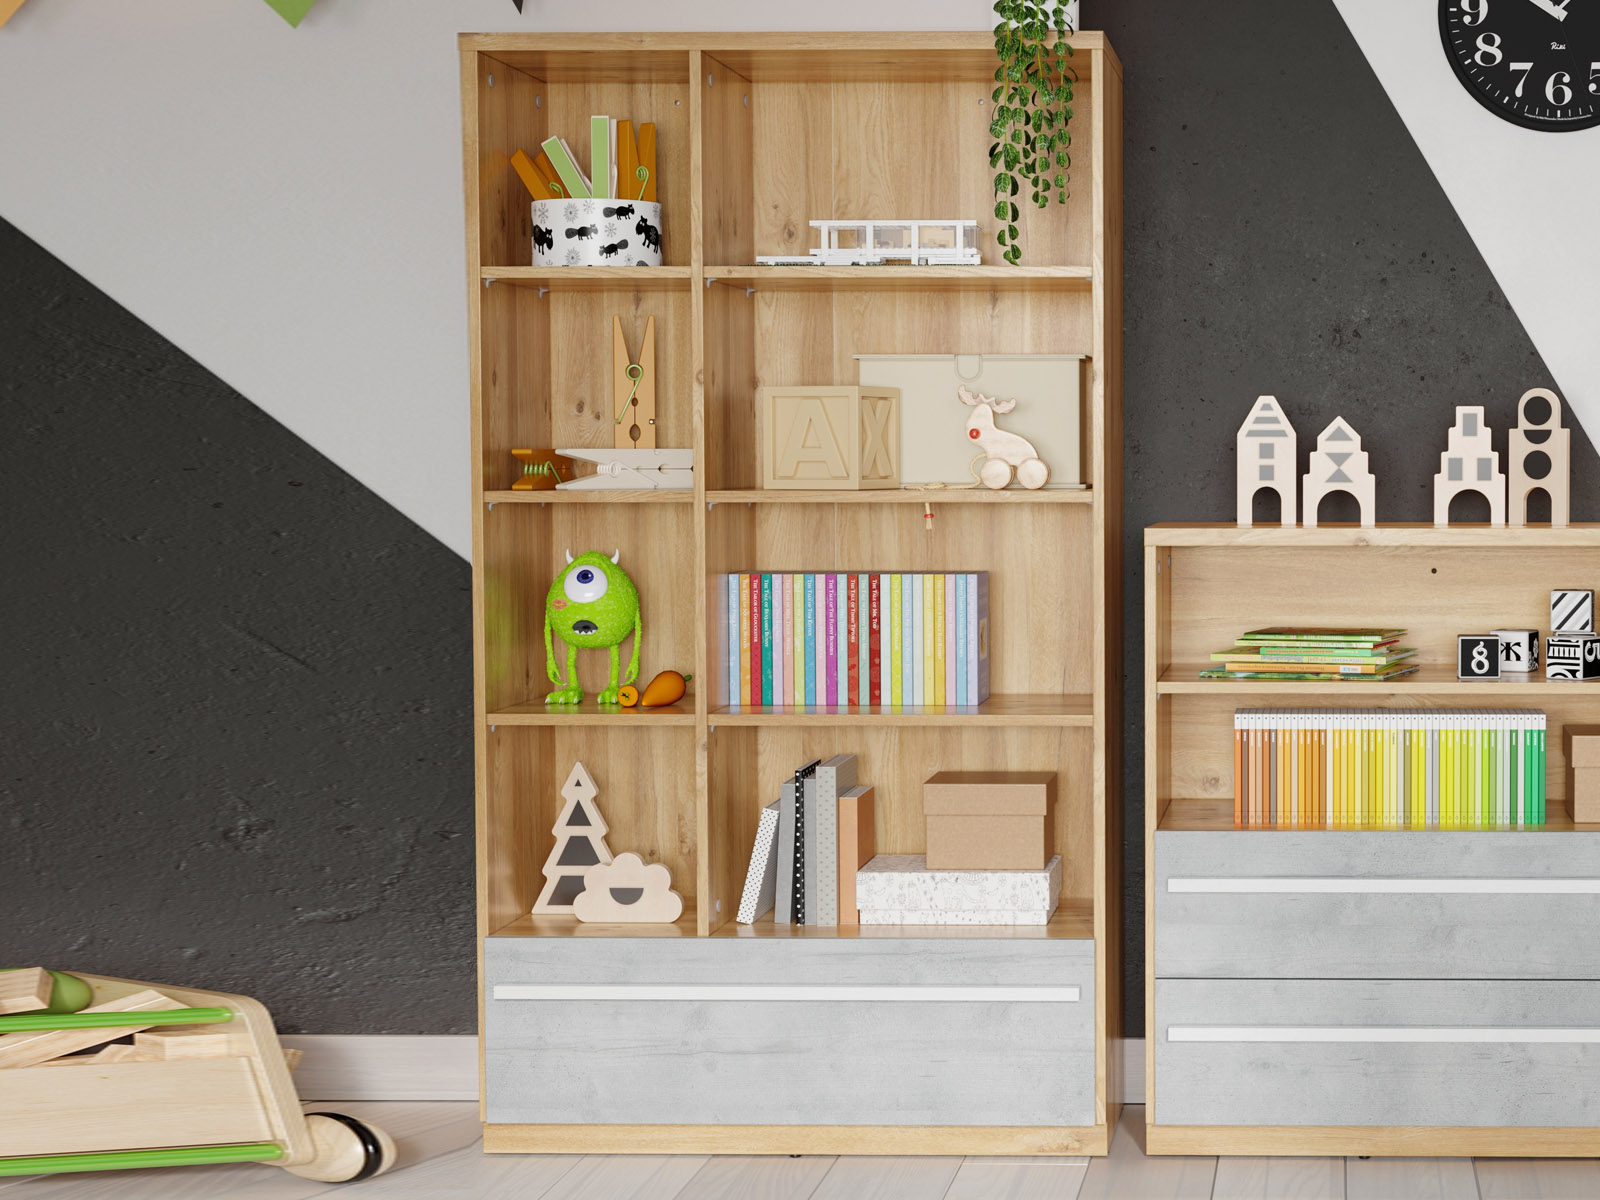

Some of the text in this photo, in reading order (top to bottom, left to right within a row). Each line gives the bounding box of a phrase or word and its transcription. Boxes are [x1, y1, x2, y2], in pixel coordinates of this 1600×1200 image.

[1460, 0, 1489, 26] 9
[1474, 32, 1503, 66] 8
[1509, 62, 1534, 98] 7
[1545, 71, 1572, 106] 6
[776, 396, 850, 479] A
[862, 398, 894, 478] X
[1471, 640, 1490, 674] 8
